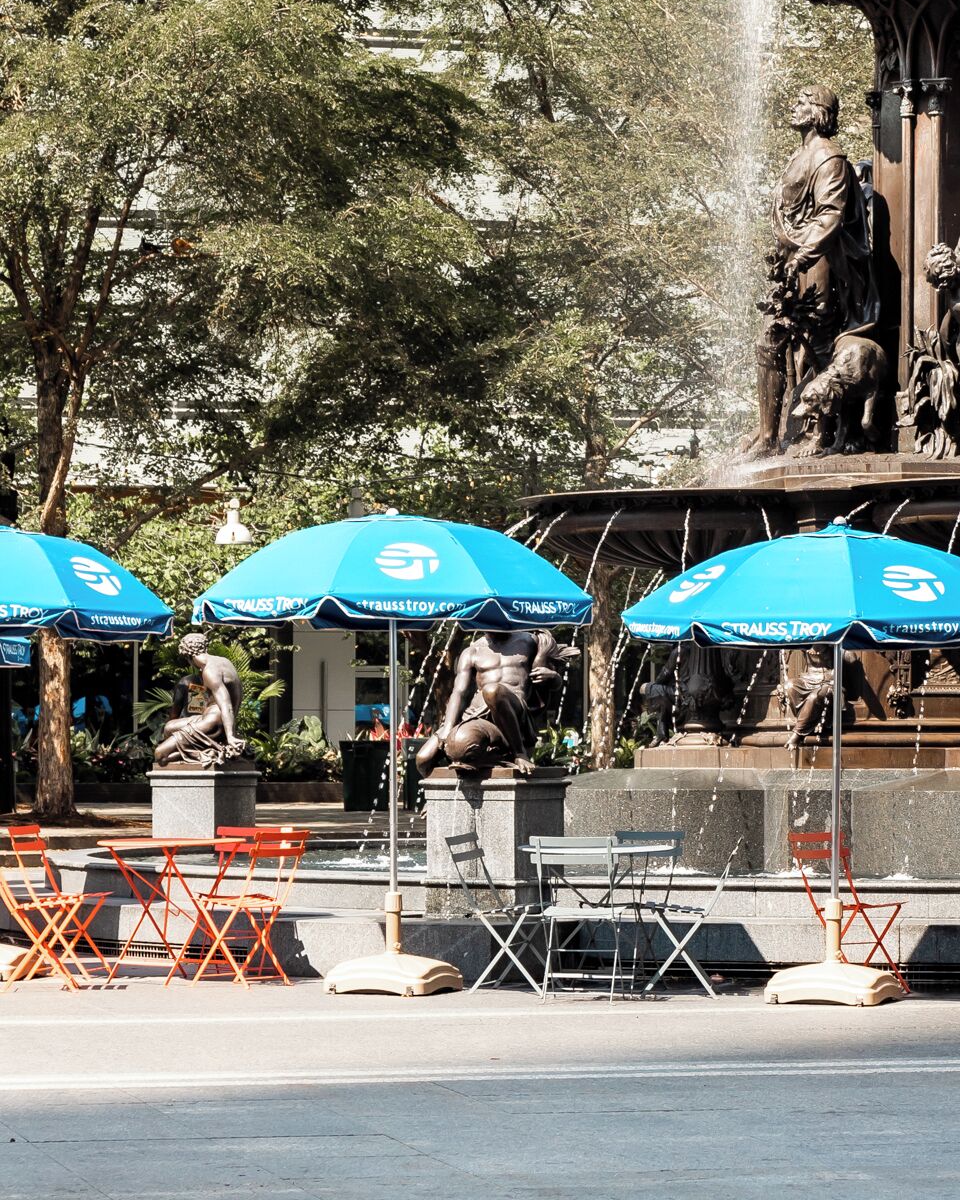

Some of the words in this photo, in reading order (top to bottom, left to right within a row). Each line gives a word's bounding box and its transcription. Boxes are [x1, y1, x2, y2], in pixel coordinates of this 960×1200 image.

[10, 604, 49, 619] TROY
[275, 596, 309, 613] TROY
[511, 600, 555, 614] STRAUSS
[721, 622, 786, 637] STRAUSS
[789, 620, 832, 636] TROY
